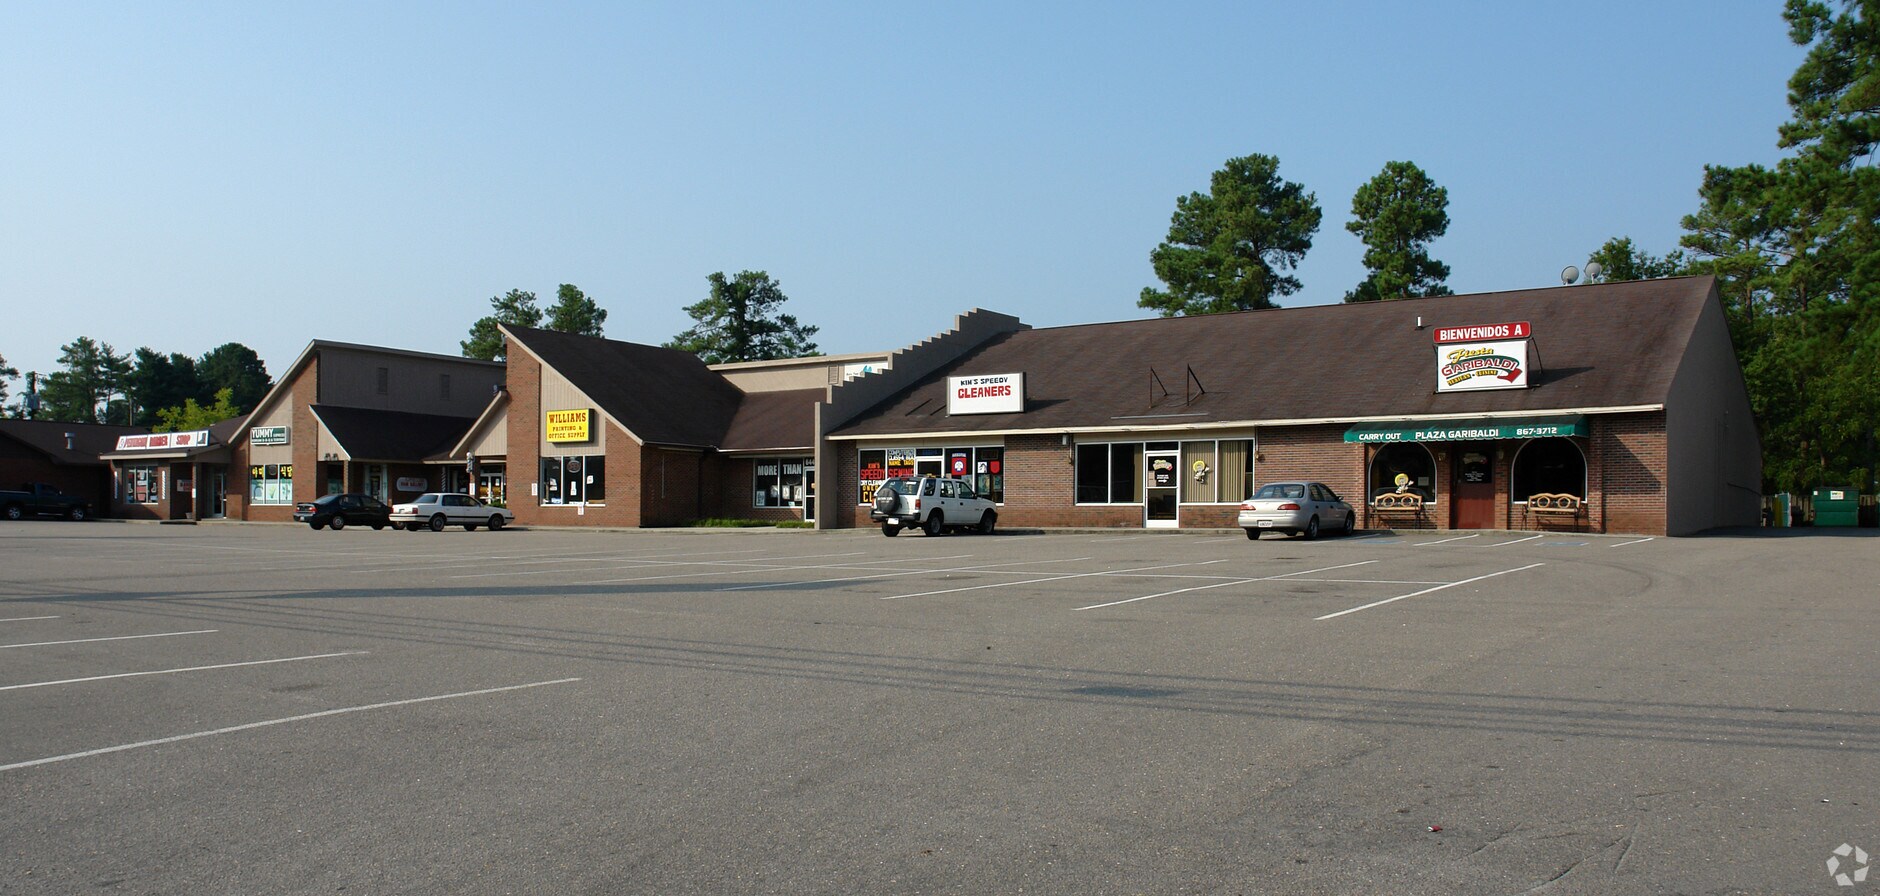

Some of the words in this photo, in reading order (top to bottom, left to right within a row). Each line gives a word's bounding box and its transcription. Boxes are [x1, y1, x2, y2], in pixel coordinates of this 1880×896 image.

[1440, 325, 1509, 341] BIENVENIDOS
[1514, 324, 1522, 336] A
[1446, 347, 1494, 363] Fiesta
[1441, 358, 1517, 376] GARIBALDI
[957, 385, 1011, 399] CLEANERS
[549, 412, 587, 424] WILLIAMS
[251, 428, 274, 438] YUMMY
[1415, 430, 1446, 439] PLAZA
[1447, 428, 1499, 438] GARIBALDI
[1516, 427, 1557, 435] 867-3712
[757, 465, 777, 476] MORE
[783, 464, 802, 475] THAN
